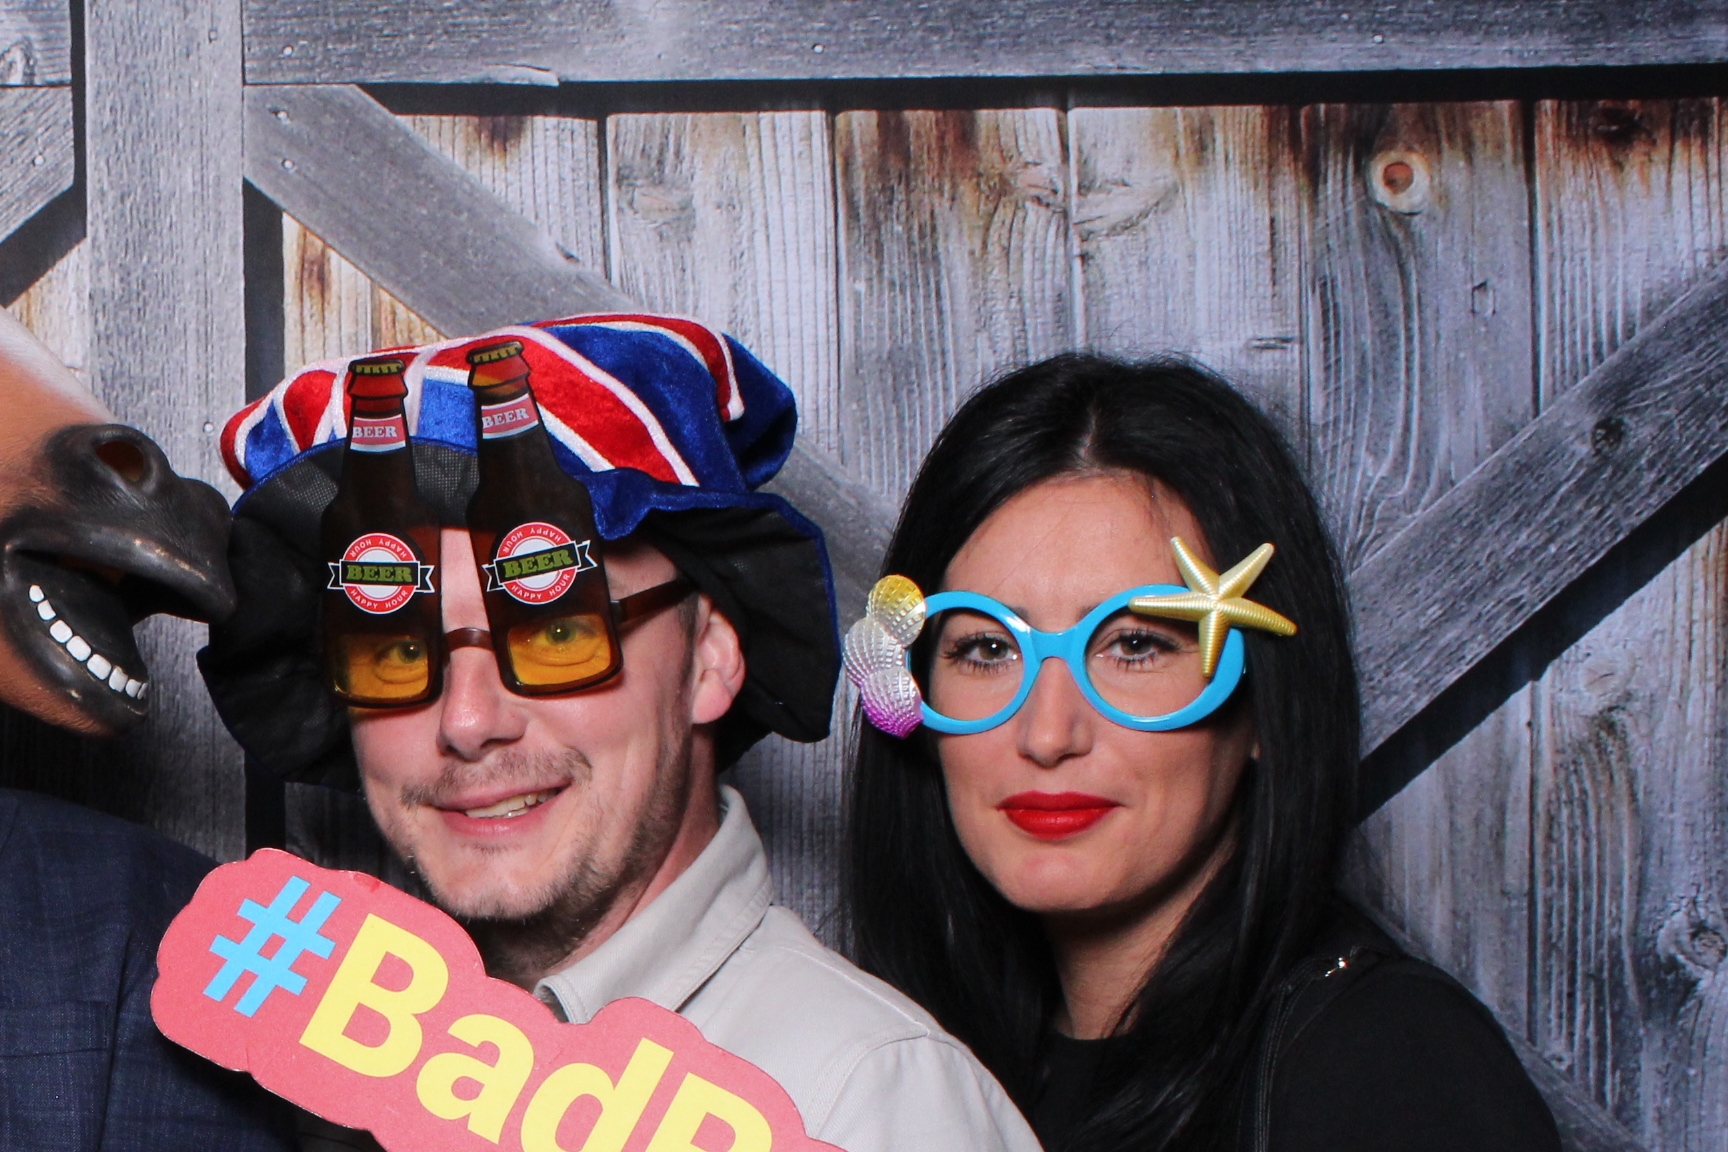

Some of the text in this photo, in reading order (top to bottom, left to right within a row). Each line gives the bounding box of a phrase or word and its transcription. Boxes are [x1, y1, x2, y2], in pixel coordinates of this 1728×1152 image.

[482, 407, 530, 429] BEER
[352, 425, 398, 438] BEER
[349, 538, 407, 559] HAPPY HOUR
[502, 527, 562, 553] HAPPY HOUR
[346, 564, 412, 583] BEER
[502, 549, 574, 578] BEER
[511, 573, 571, 600] HAPPY HOUR
[350, 589, 408, 609] HAPPY HOUR
